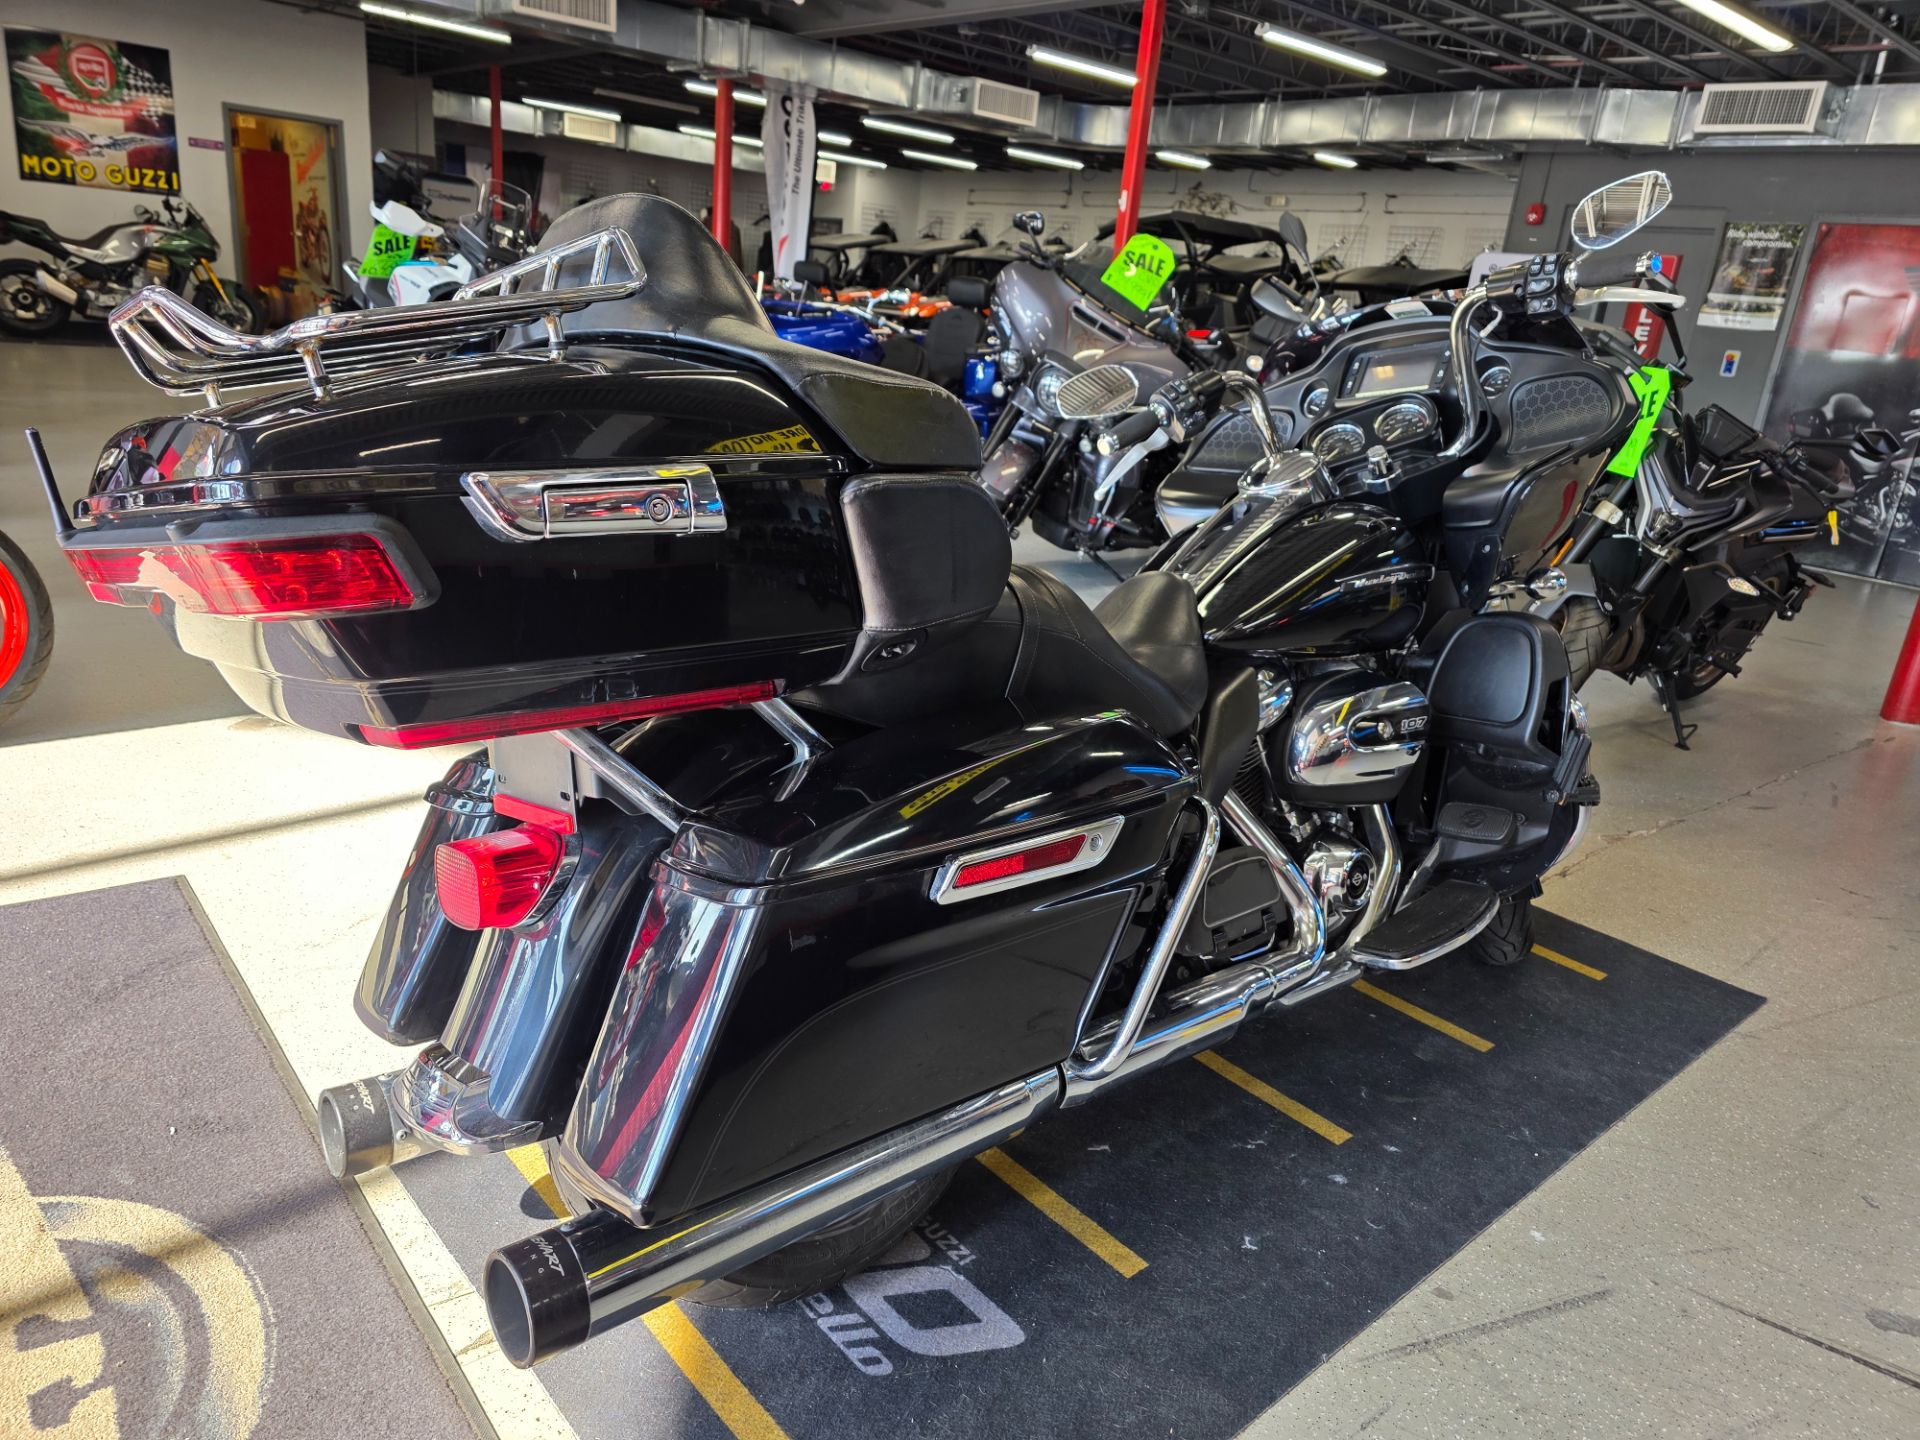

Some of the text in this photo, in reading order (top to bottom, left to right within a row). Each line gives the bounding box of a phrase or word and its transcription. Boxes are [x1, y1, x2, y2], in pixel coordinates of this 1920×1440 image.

[794, 128, 805, 169] Ultimate
[21, 153, 180, 191] MOTO GUZZI
[791, 174, 802, 195] The
[373, 235, 411, 257] SALE
[1727, 228, 1781, 240] Ride without
[1122, 249, 1167, 278] SALE
[1638, 389, 1660, 420] LE
[1400, 715, 1429, 731] 107
